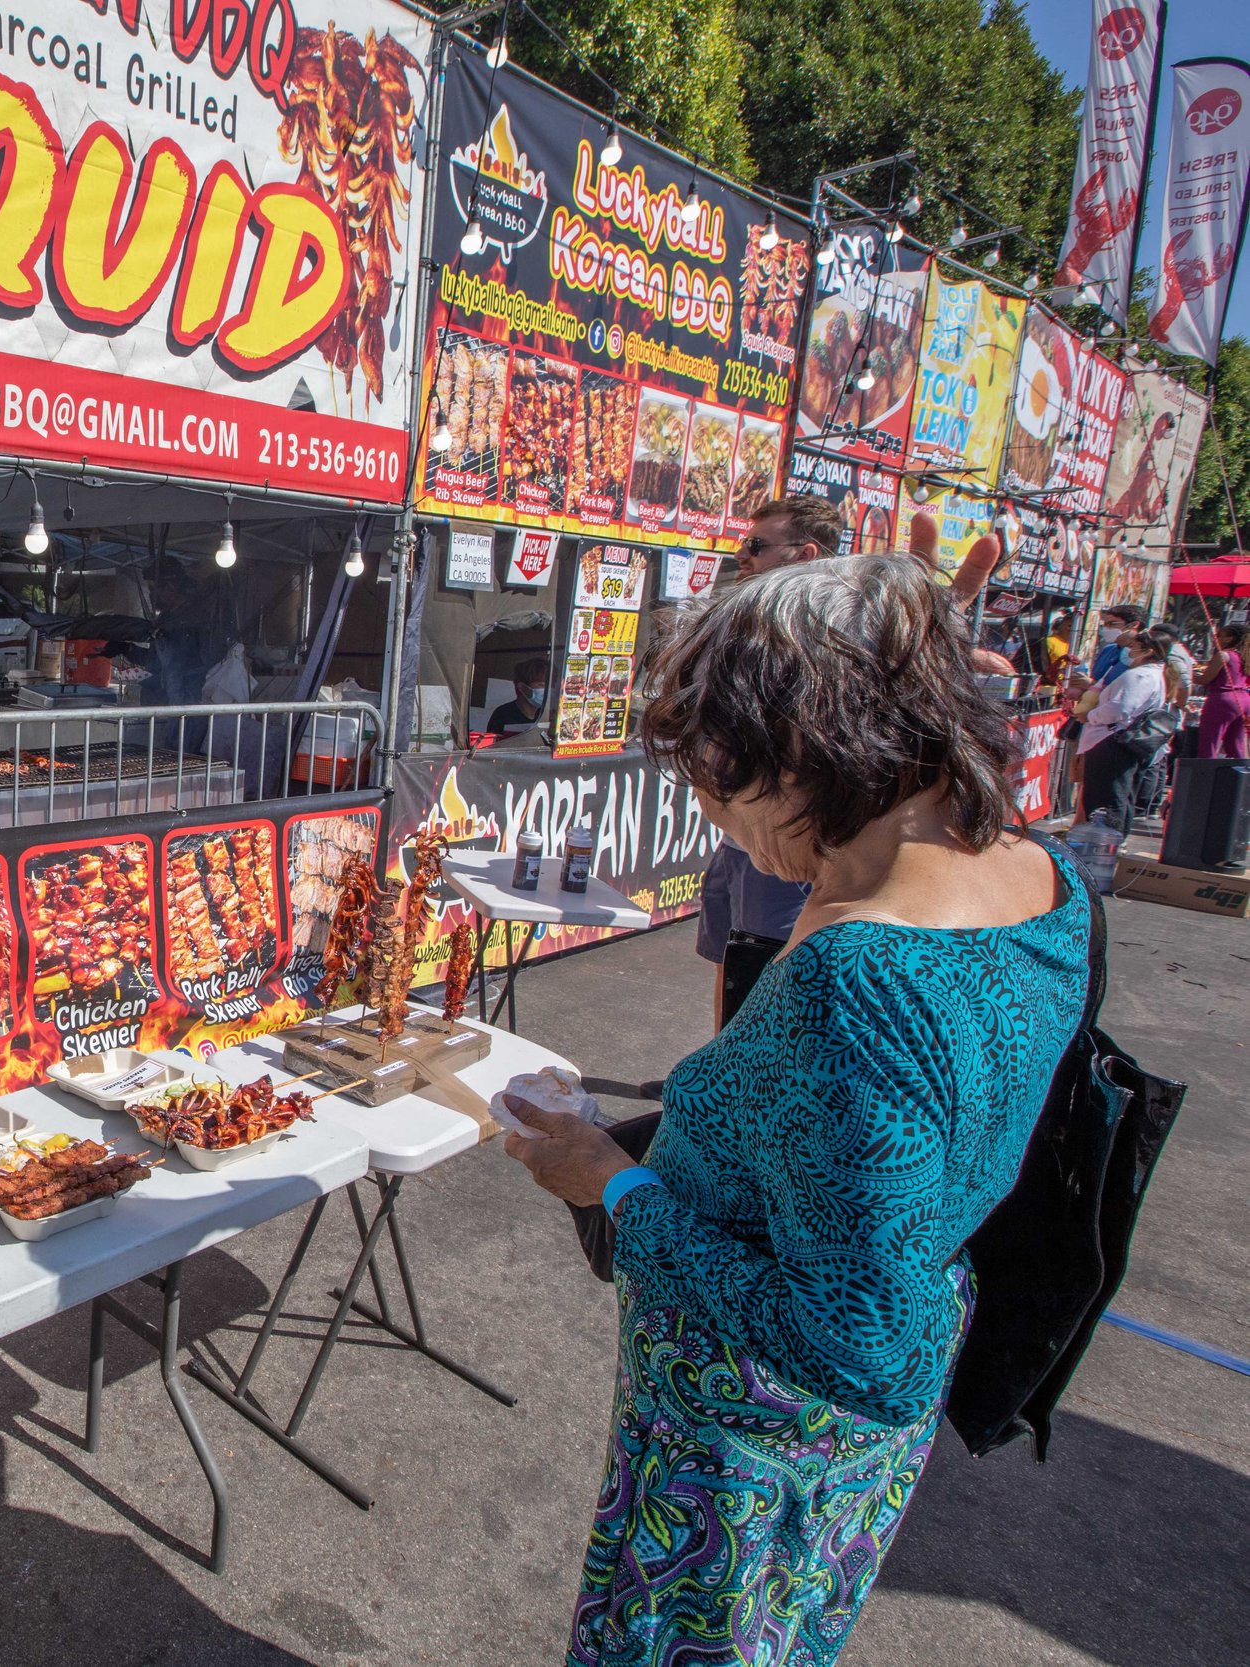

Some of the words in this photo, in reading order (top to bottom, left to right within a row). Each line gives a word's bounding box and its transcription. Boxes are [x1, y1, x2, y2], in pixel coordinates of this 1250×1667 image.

[476, 183, 523, 210] uckyball
[504, 212, 527, 235] BBQ
[551, 208, 666, 318] Korean
[671, 263, 731, 342] BBQ
[441, 267, 577, 342] luckyballbbq@gmail.com
[741, 328, 764, 354] Squid
[764, 336, 795, 364] Skewers
[919, 368, 978, 417] TOKYO
[913, 407, 974, 454] LEMON
[258, 429, 399, 483] 213-536-9610
[435, 469, 464, 485] Angus
[465, 474, 487, 488] Beef
[793, 452, 852, 487] TAKOYAKI
[435, 487, 450, 501] Rib
[451, 489, 485, 506] Skewer
[518, 483, 549, 500] Chicken
[858, 487, 896, 510] TAKOYAKI
[516, 500, 549, 516] Skewers
[579, 494, 597, 508] Pork
[597, 497, 614, 513] Belly
[639, 504, 655, 516] Beef
[655, 506, 666, 518] Rib
[580, 510, 610, 525] Skewers
[641, 520, 659, 532] Plate
[683, 513, 698, 524] Beef
[726, 518, 747, 529] Chicken
[453, 533, 475, 547] Evelyn
[476, 536, 490, 548] Kim
[691, 528, 708, 538] Plate
[522, 537, 550, 553] PICK-UP
[603, 545, 630, 564] MENU
[450, 554, 463, 563] Los
[463, 555, 491, 566] Angeles
[522, 555, 542, 572] HERE
[694, 559, 715, 574] ORDER
[453, 569, 464, 581] CA
[466, 571, 487, 583] 90005
[600, 566, 612, 574] SQUID
[601, 575, 623, 599] $19
[603, 599, 616, 607] EACH
[504, 768, 646, 878] KOREAN
[1126, 867, 1170, 880] BEEF
[285, 954, 324, 974] Angu
[180, 974, 222, 1003] Pork
[226, 966, 267, 993] Belly
[282, 974, 308, 999] Rib
[55, 998, 147, 1033] Chicken
[205, 993, 263, 1025] Skewer
[62, 1023, 141, 1060] Skewer
[122, 1067, 147, 1082] SKEWER
